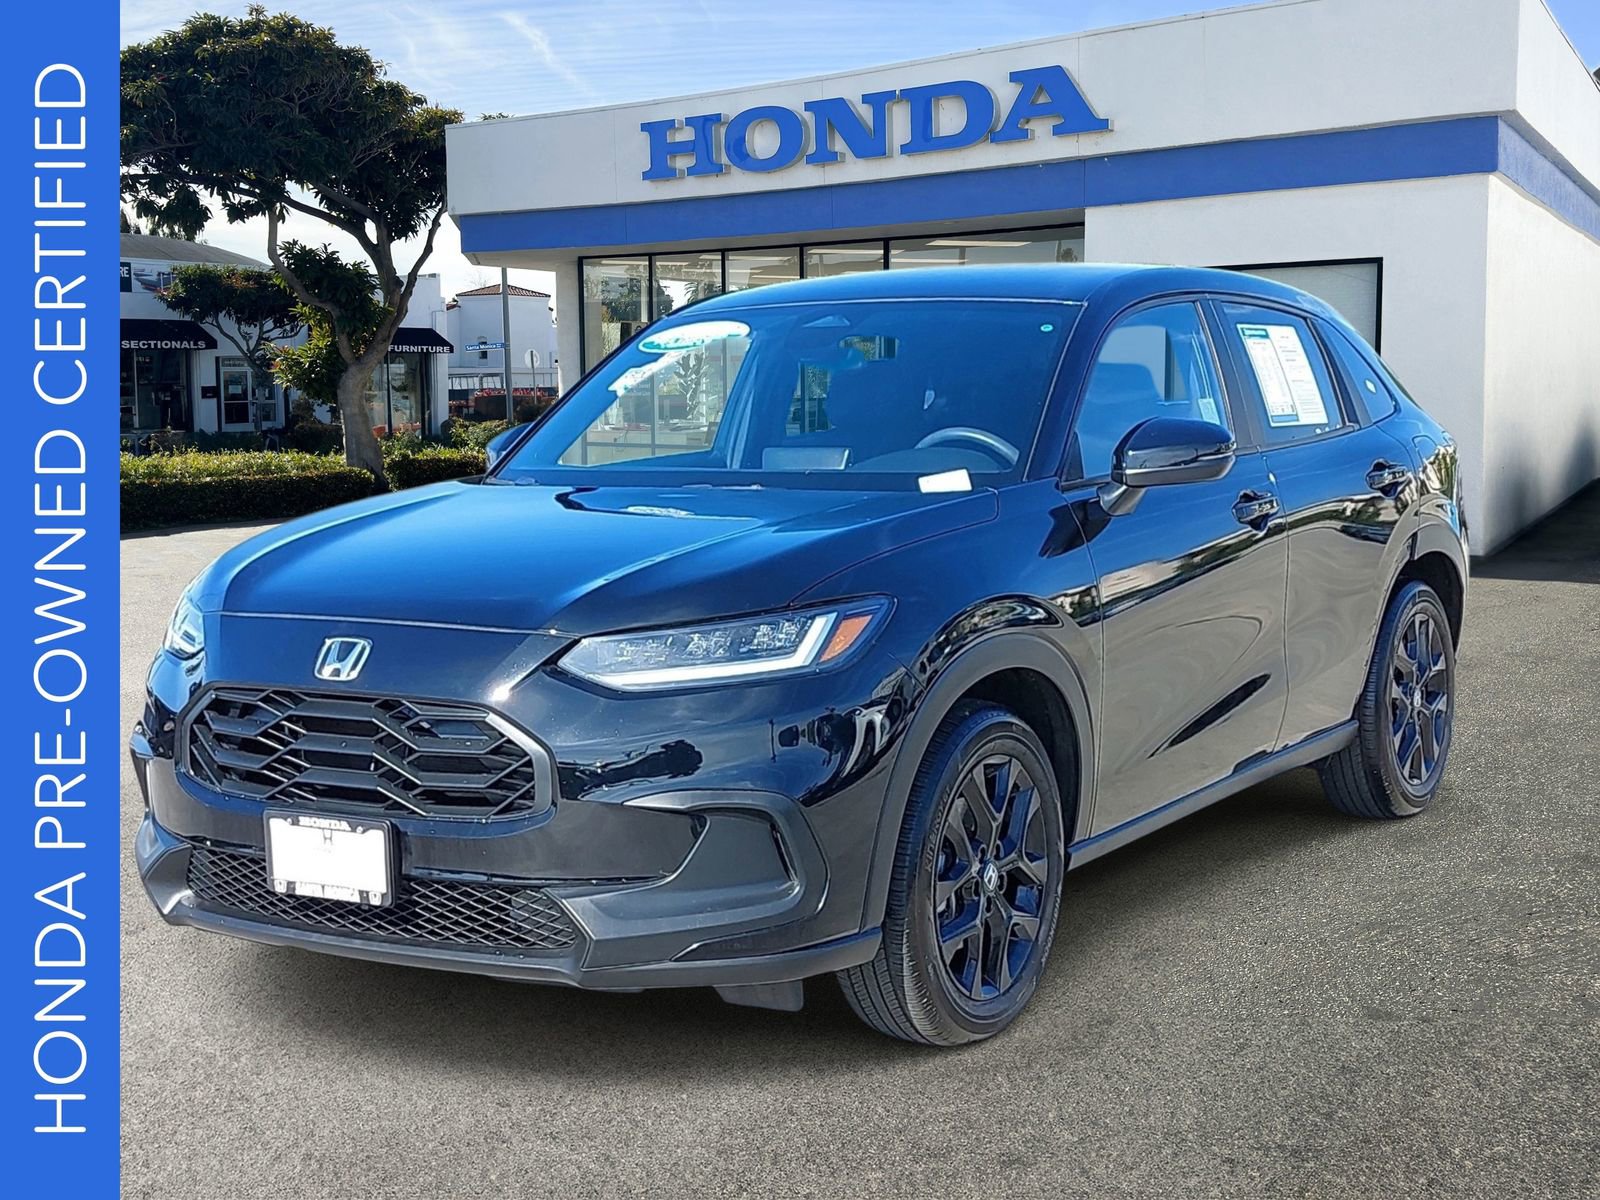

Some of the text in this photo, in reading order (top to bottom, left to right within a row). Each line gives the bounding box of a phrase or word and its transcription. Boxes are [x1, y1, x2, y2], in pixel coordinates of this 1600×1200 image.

[640, 65, 1112, 181] HONDA
[121, 340, 207, 349] SECTIONALS
[388, 344, 451, 353] FURNITURE
